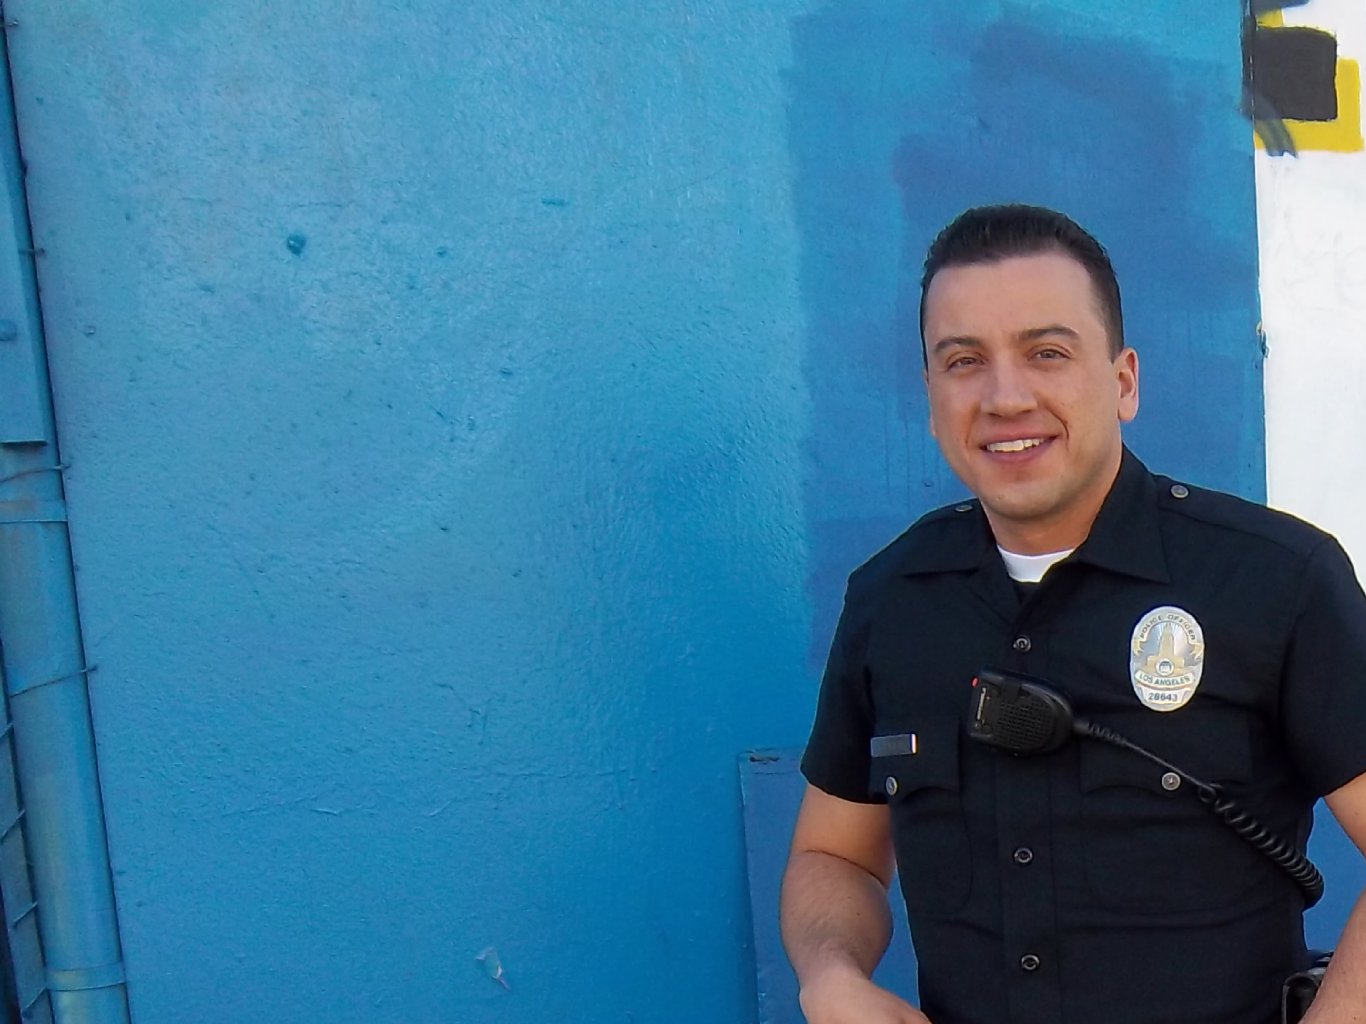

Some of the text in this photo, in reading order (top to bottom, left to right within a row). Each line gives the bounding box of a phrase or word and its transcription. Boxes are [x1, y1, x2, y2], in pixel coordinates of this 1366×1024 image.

[1140, 614, 1196, 640] POLICE OFFICER
[1139, 673, 1190, 686] LOS ANGELES
